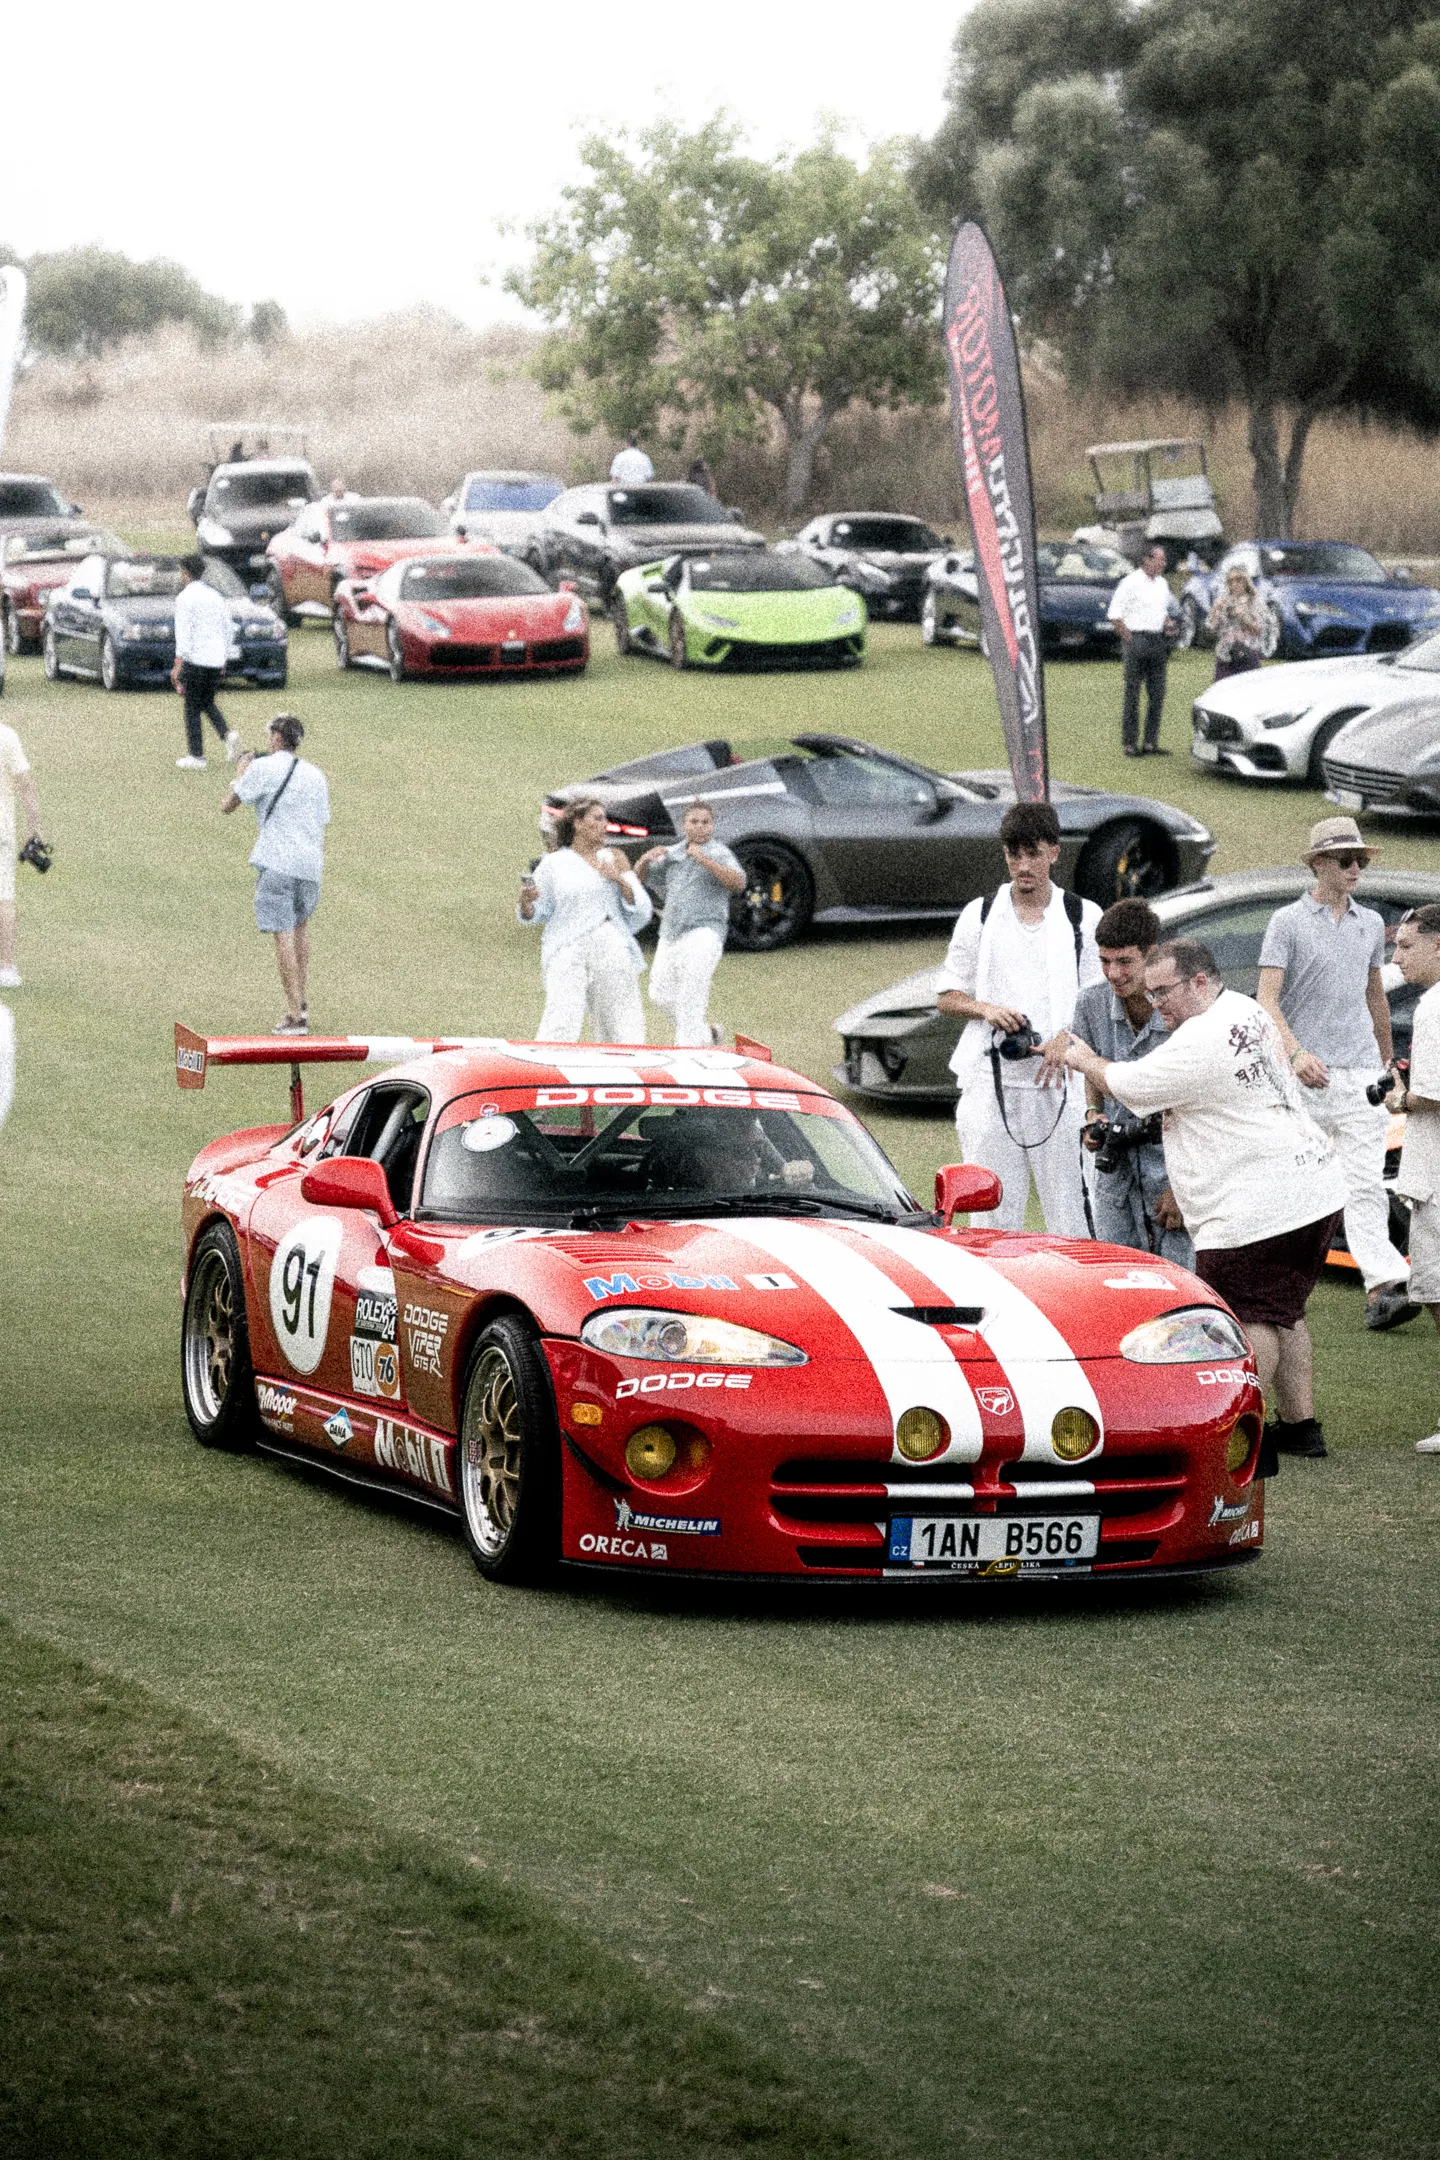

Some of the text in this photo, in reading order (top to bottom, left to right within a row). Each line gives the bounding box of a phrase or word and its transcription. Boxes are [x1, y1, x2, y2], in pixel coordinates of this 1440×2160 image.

[535, 1087, 801, 1111] DODGE
[282, 1243, 325, 1339] 91
[583, 1272, 740, 1300] Mobil
[356, 1298, 388, 1323] ROLEX
[403, 1303, 449, 1334] DODGE
[381, 1315, 396, 1340] 24
[352, 1340, 374, 1381] GTO
[408, 1328, 442, 1368] VIPER
[378, 1355, 395, 1384] 76
[615, 1373, 753, 1399] DODGE
[329, 1422, 347, 1440] DANA
[374, 1418, 432, 1483] Mobil
[634, 1514, 718, 1532] MICHELIN
[579, 1533, 649, 1559] ORECA
[892, 1546, 908, 1556] CZ
[921, 1521, 1084, 1557] 1AN B566
[951, 1561, 980, 1569] ČESKÁ
